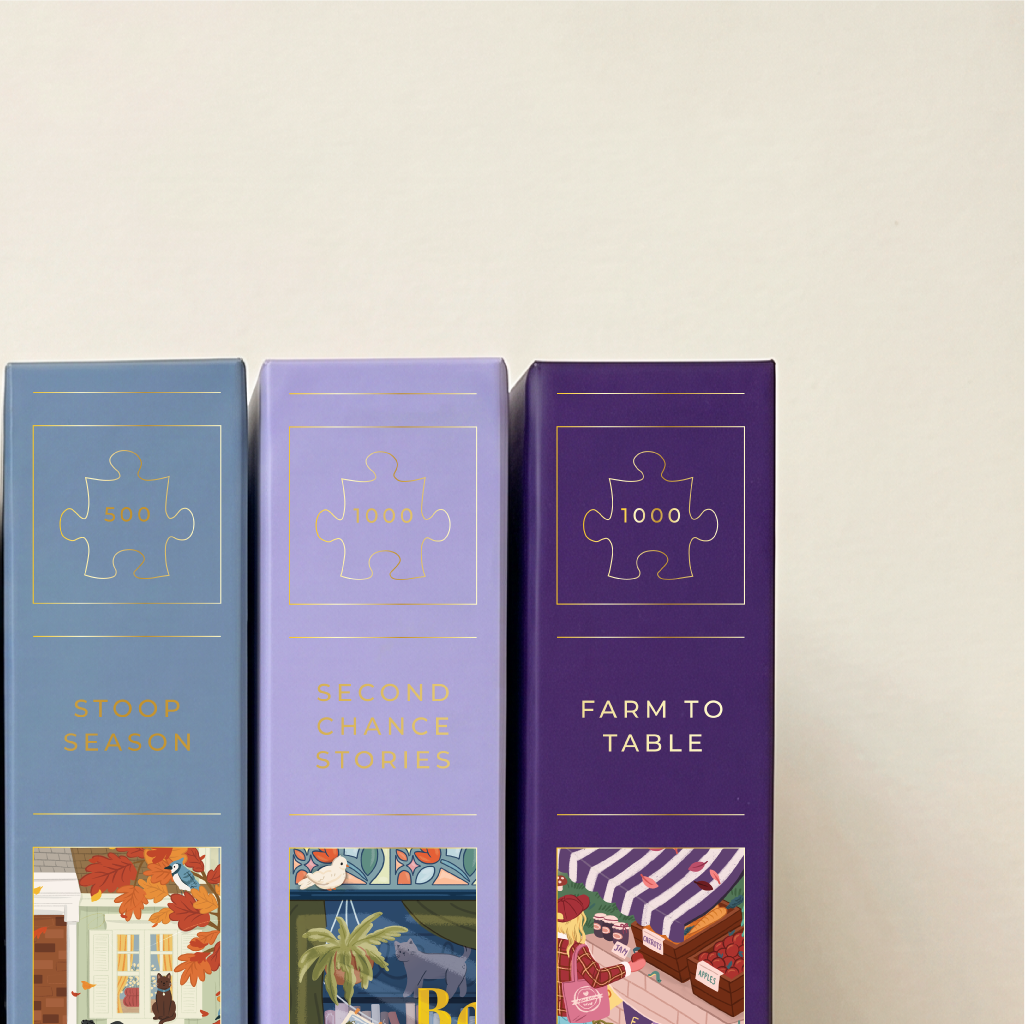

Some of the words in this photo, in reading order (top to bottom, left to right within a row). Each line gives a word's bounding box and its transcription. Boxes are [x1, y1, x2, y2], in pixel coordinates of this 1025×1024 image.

[104, 507, 151, 523] 500
[353, 507, 414, 523] 1000
[621, 507, 681, 523] 1000
[317, 683, 450, 702] SECOND
[74, 699, 181, 718] STOOP
[581, 700, 667, 719] FARM
[684, 700, 724, 719] TO
[317, 717, 450, 736] CHANCE
[64, 733, 191, 752] SEASON
[603, 734, 703, 753] TABLE
[316, 751, 451, 770] STORIES
[614, 944, 629, 956] JAM
[698, 970, 716, 985] APPLES
